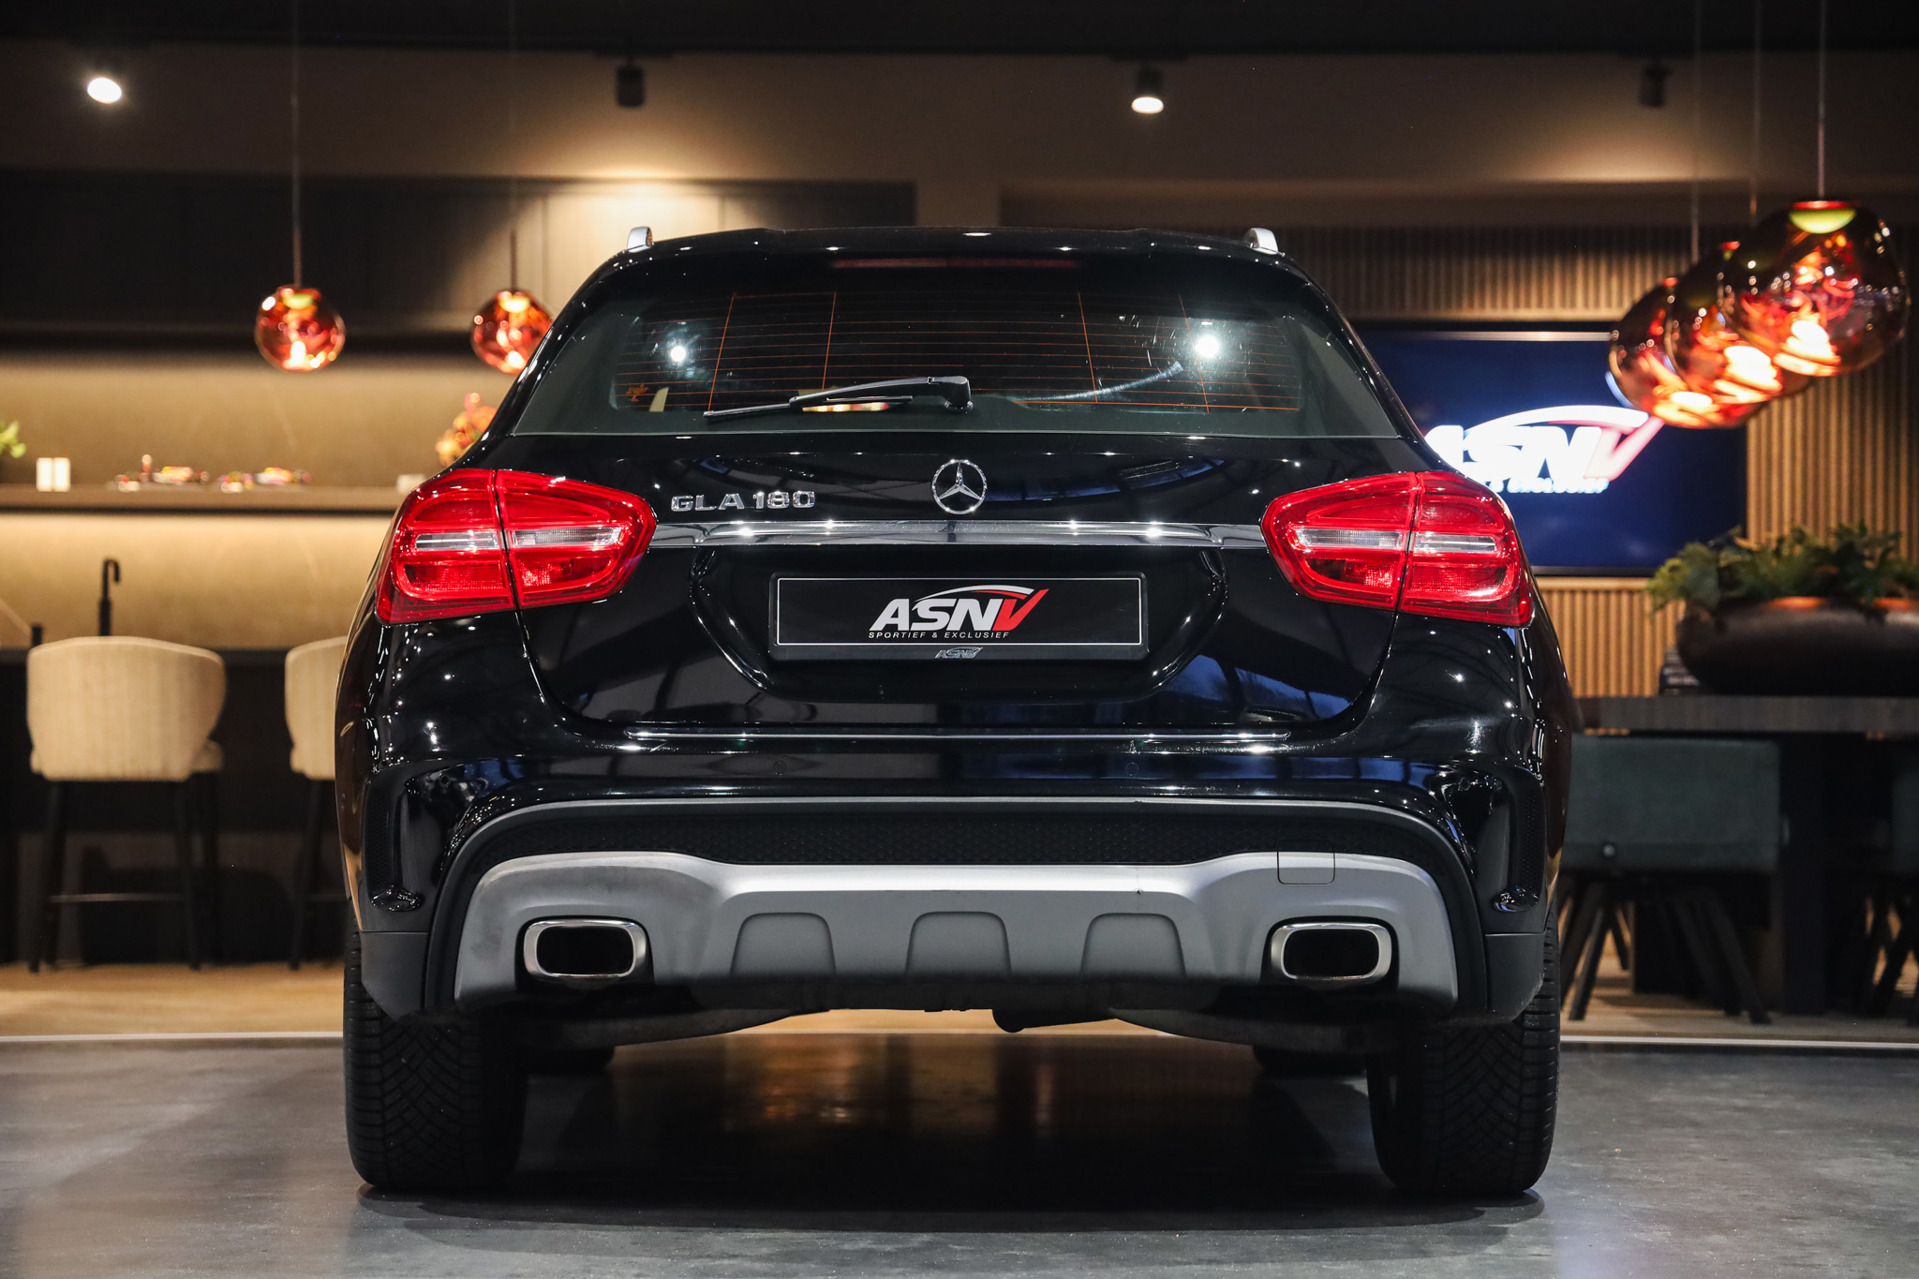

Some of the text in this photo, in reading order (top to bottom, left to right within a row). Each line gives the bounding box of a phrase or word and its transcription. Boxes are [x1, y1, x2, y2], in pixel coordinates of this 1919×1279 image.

[670, 489, 816, 512] GLA 180
[868, 588, 1050, 632] ASNV
[868, 631, 1010, 639] SPORTIEF & EXCLUSIEF
